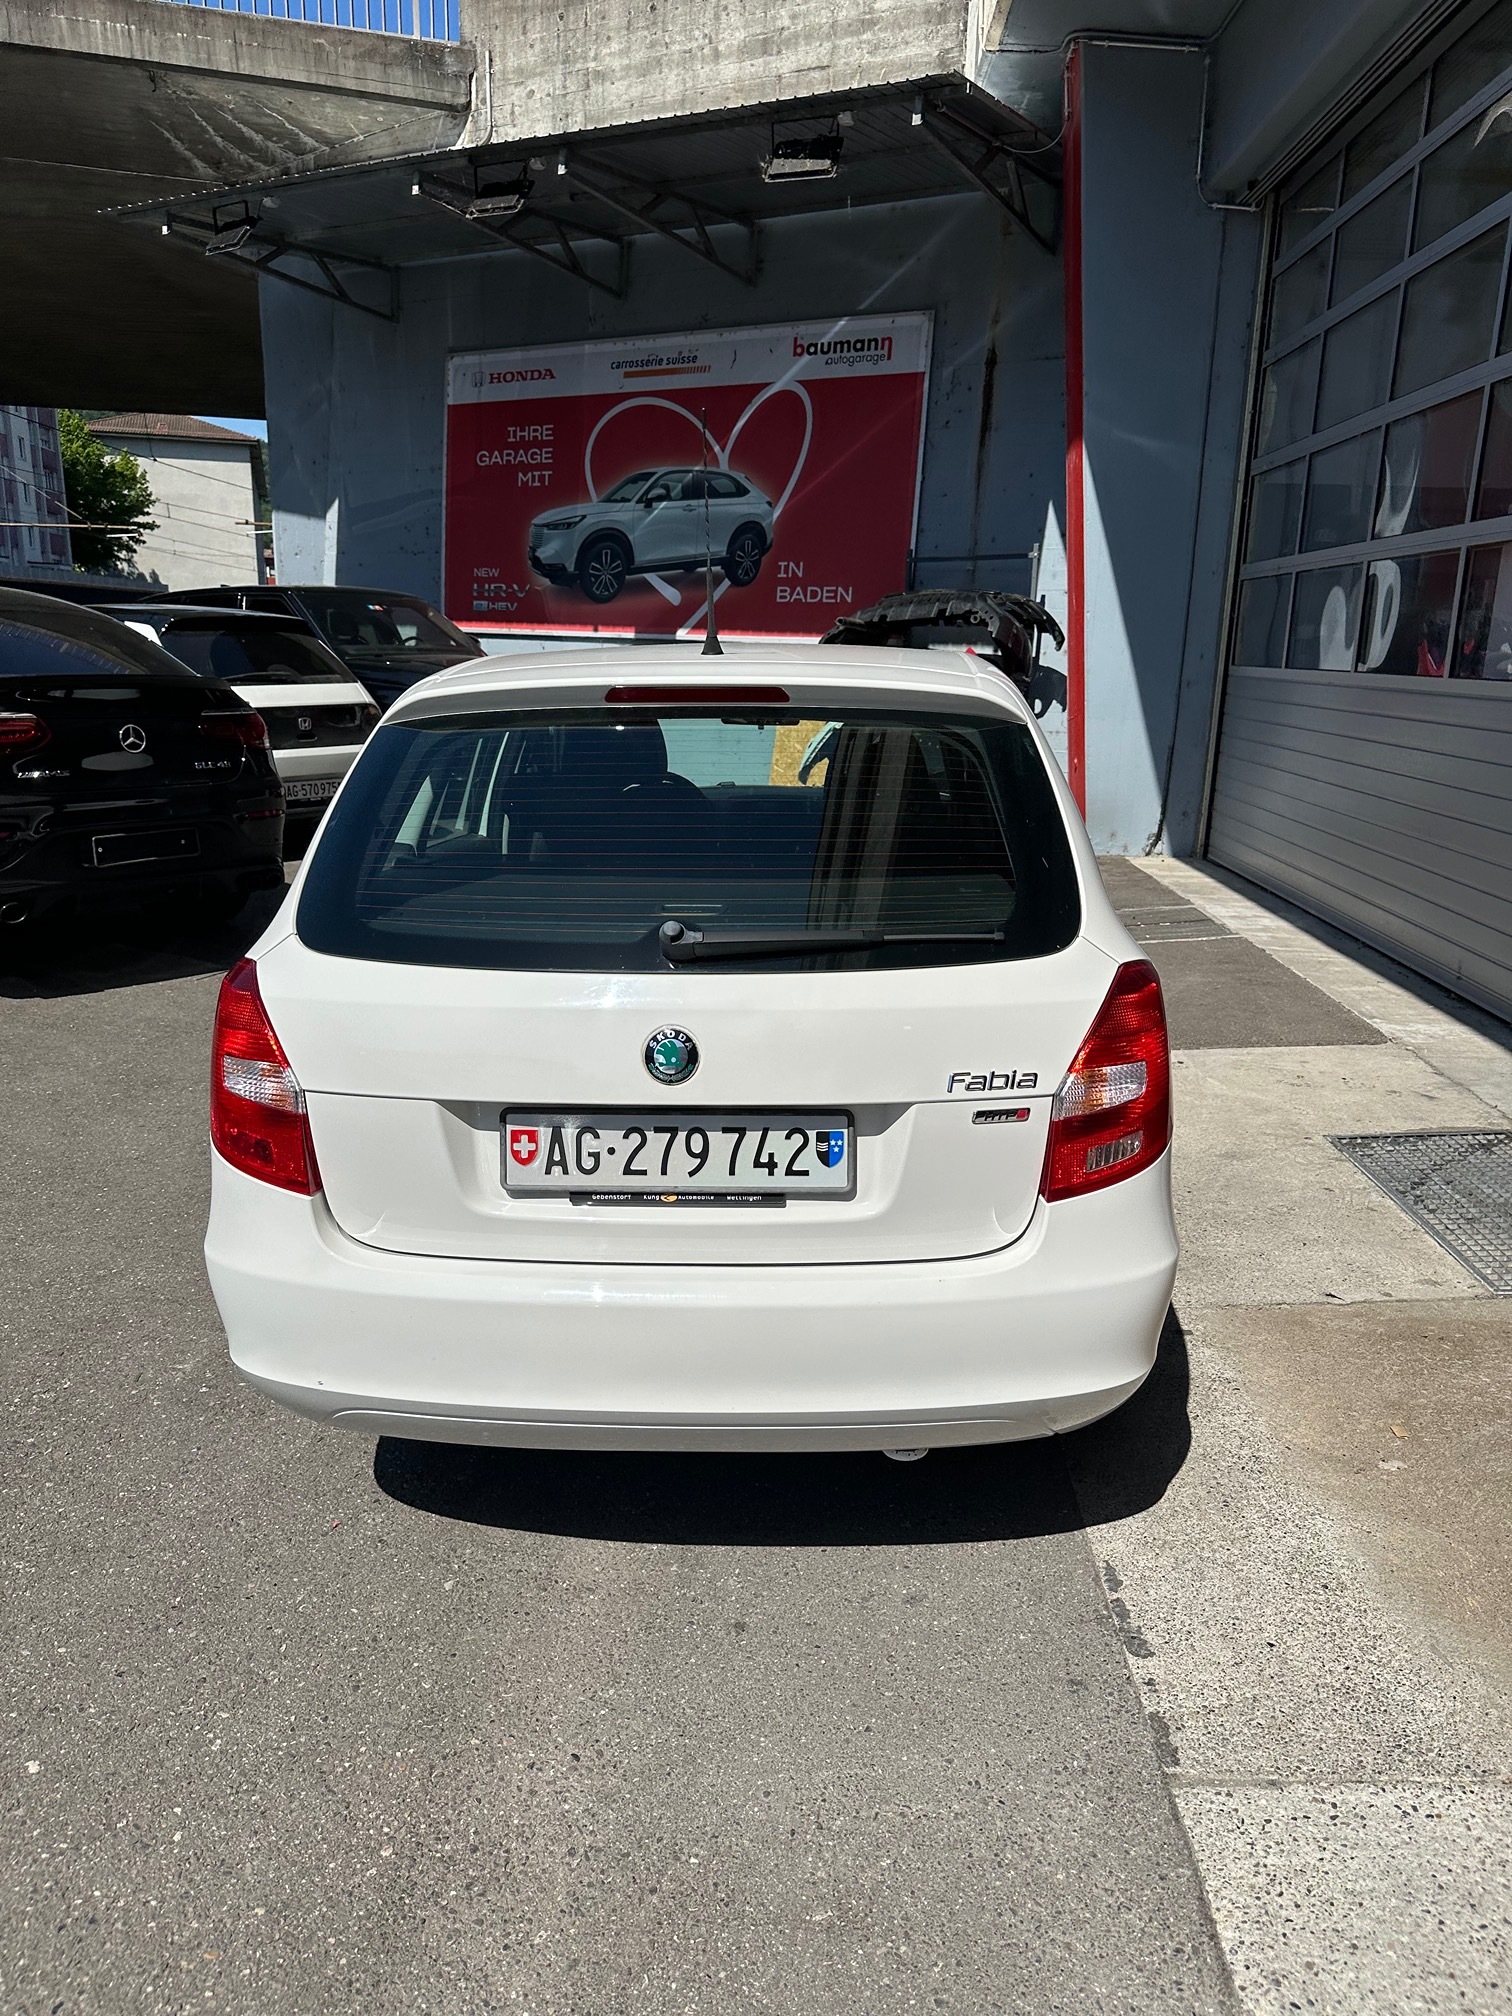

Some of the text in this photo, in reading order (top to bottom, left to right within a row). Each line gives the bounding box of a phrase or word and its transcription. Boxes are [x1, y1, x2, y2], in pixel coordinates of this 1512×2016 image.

[793, 336, 893, 360] baumann
[611, 353, 699, 370] carrosserie suisse
[825, 353, 886, 367] autogarage
[488, 368, 557, 385] HONDA
[507, 424, 555, 443] IHRE
[476, 448, 554, 466] GARAGE
[517, 471, 551, 488] MIT
[473, 568, 500, 578] NEW
[777, 561, 804, 579] IN
[473, 583, 531, 598] HR-V
[776, 586, 854, 604] BADEN
[947, 1069, 1039, 1093] Fabia
[726, 1194, 762, 1202] Wettingen
